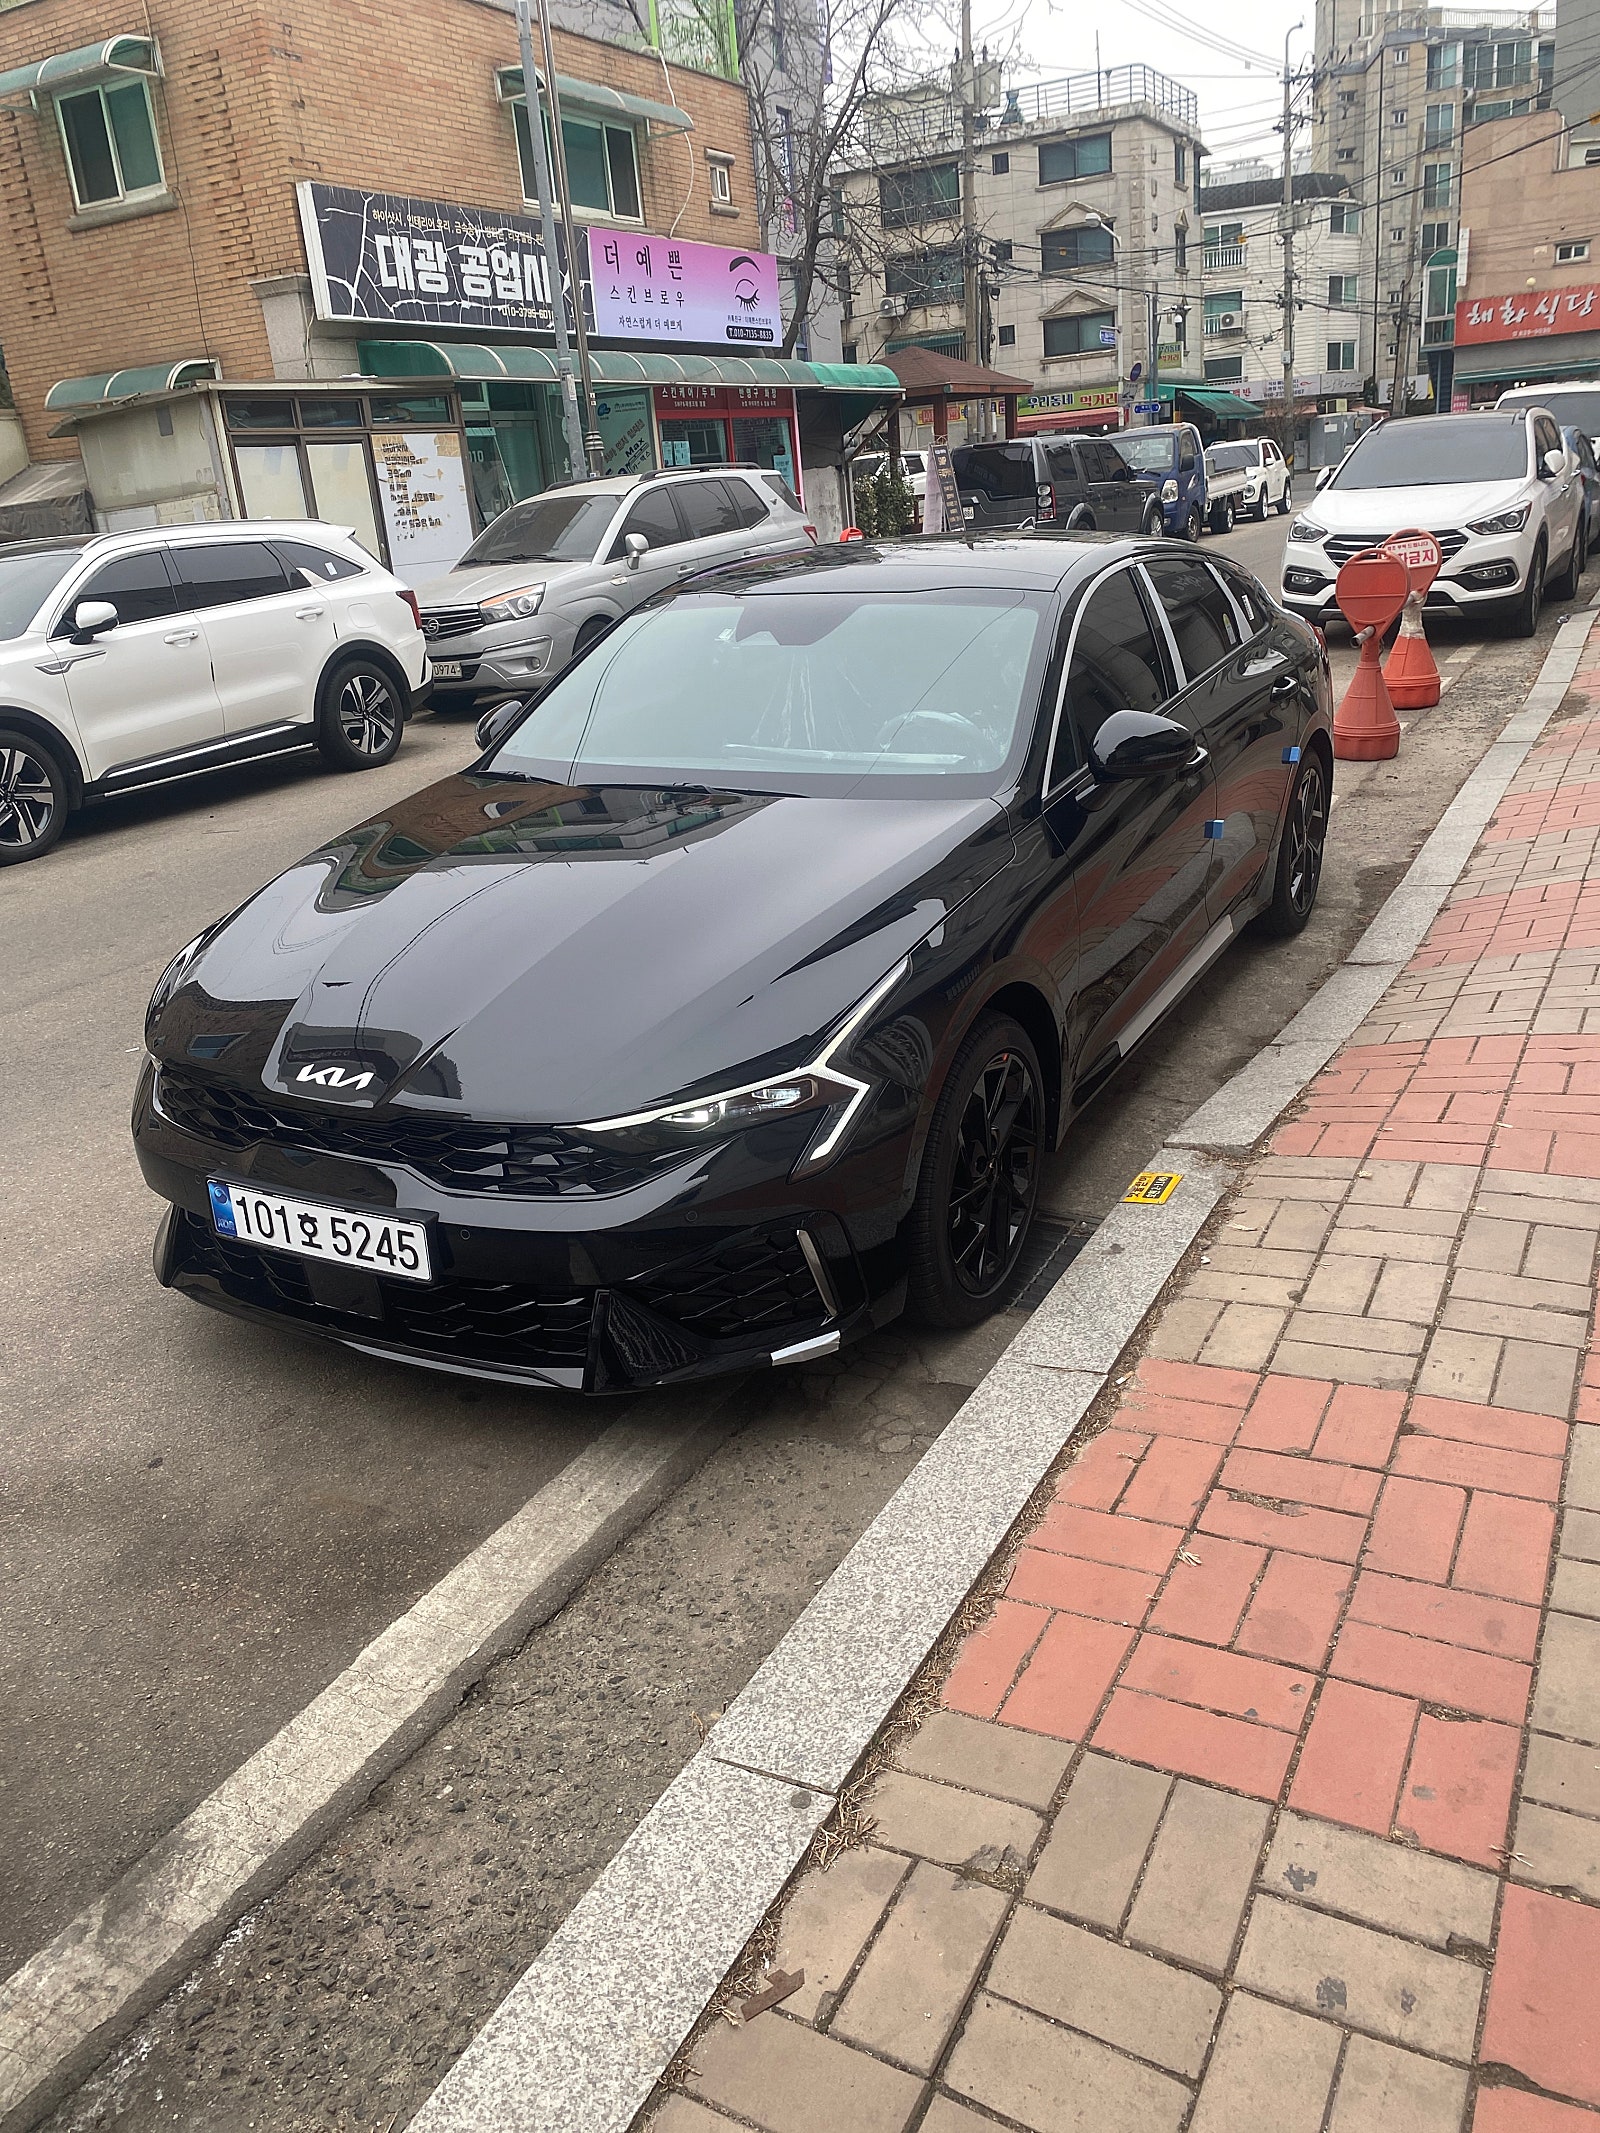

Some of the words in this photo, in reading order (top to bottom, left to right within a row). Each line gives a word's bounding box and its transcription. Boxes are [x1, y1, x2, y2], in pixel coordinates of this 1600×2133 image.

[374, 234, 450, 294] 대광
[610, 285, 685, 308] 스킨브로우
[618, 315, 652, 330] 자연스럽게
[1028, 393, 1074, 408] 우리동네
[1080, 392, 1118, 407] 먹거리
[1396, 548, 1434, 565] 차금지
[296, 1063, 375, 1090] KIA
[235, 1196, 323, 1250] 101호
[330, 1217, 419, 1270] 5245
